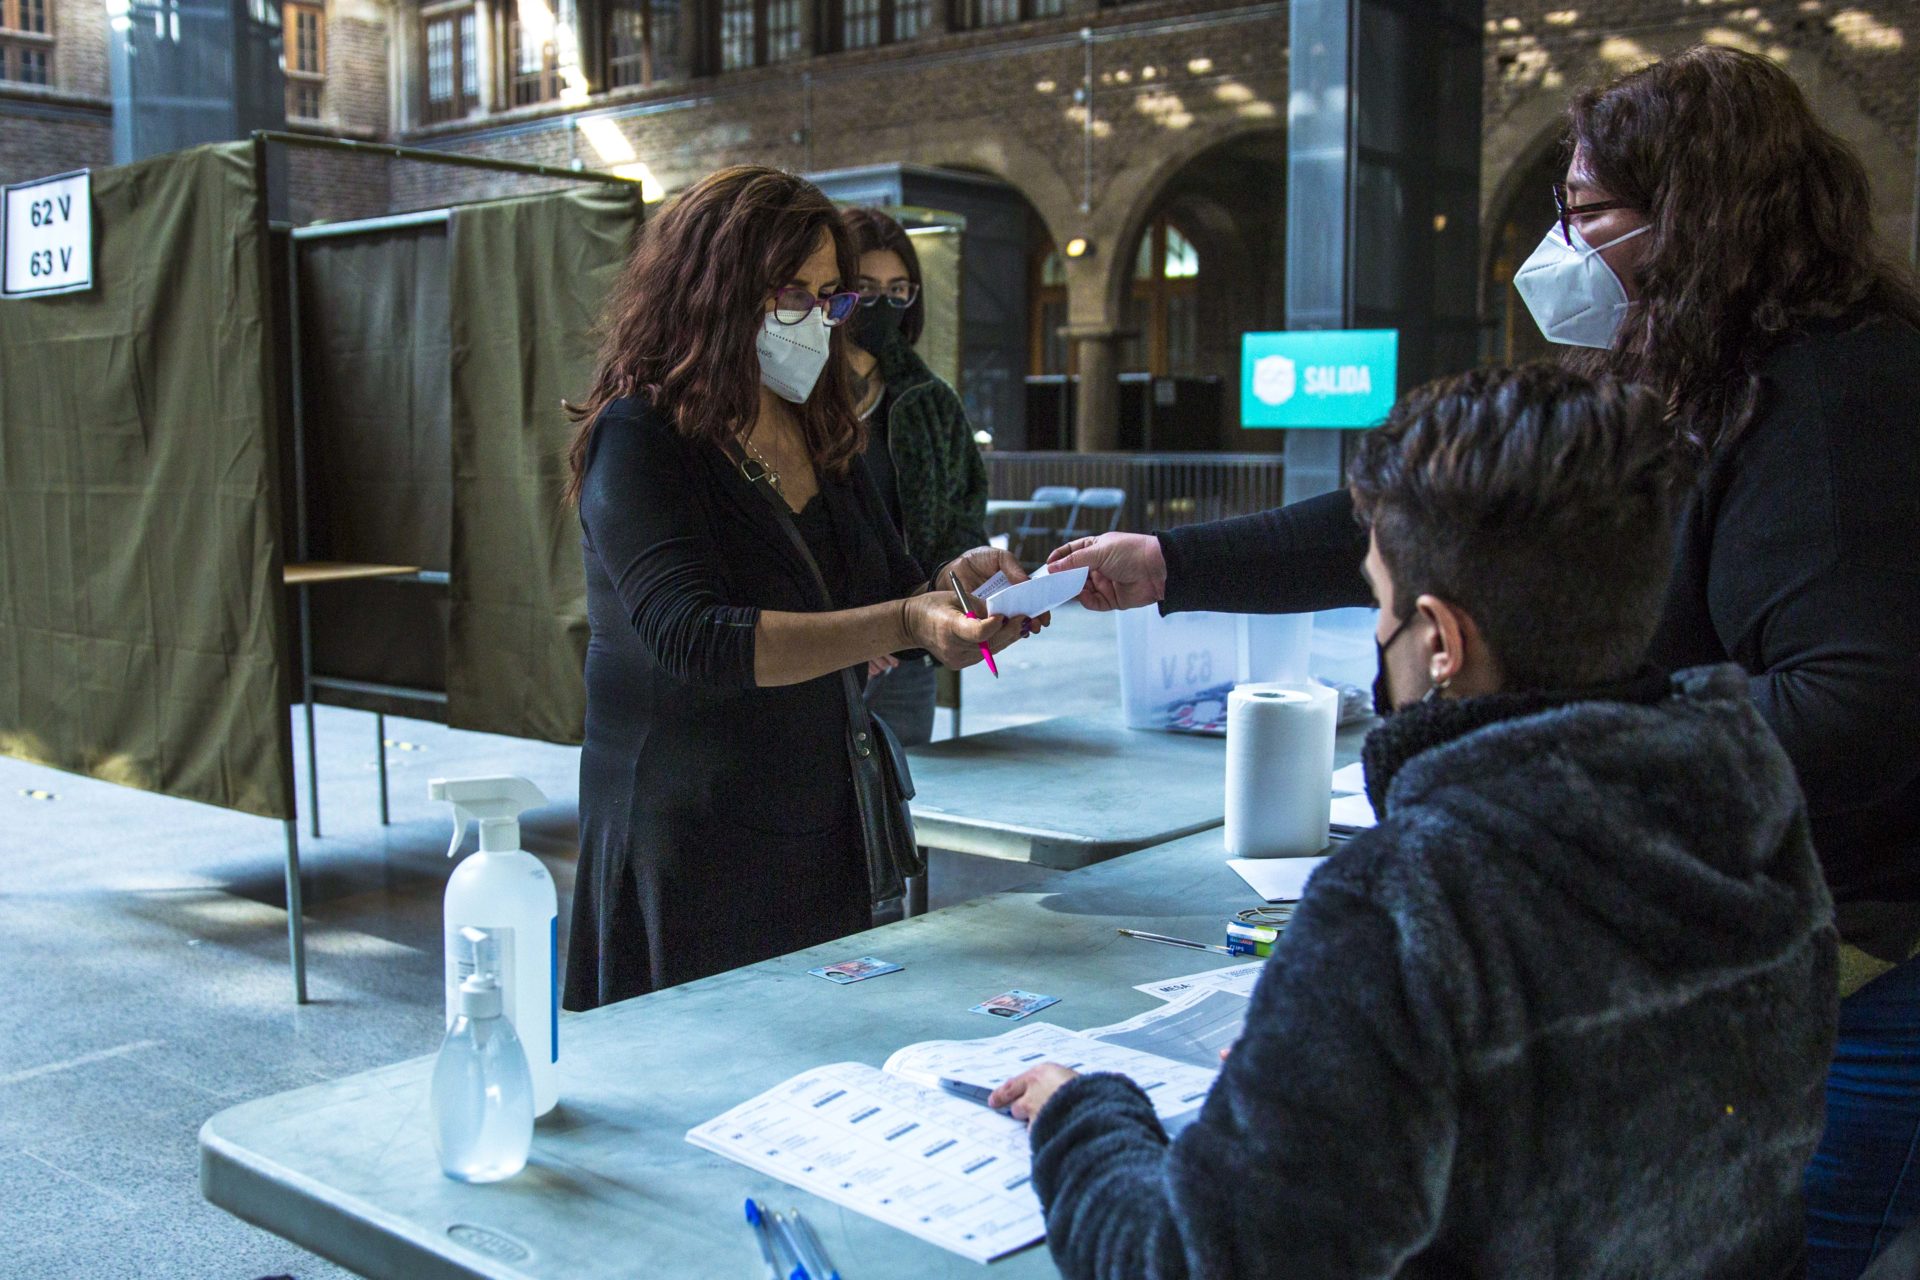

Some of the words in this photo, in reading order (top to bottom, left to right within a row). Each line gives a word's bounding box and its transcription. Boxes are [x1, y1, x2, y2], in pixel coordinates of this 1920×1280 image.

[31, 199, 54, 227] 62
[58, 194, 71, 221] V
[30, 249, 53, 277] 63
[60, 247, 72, 272] V
[1304, 364, 1372, 395] SALIDA
